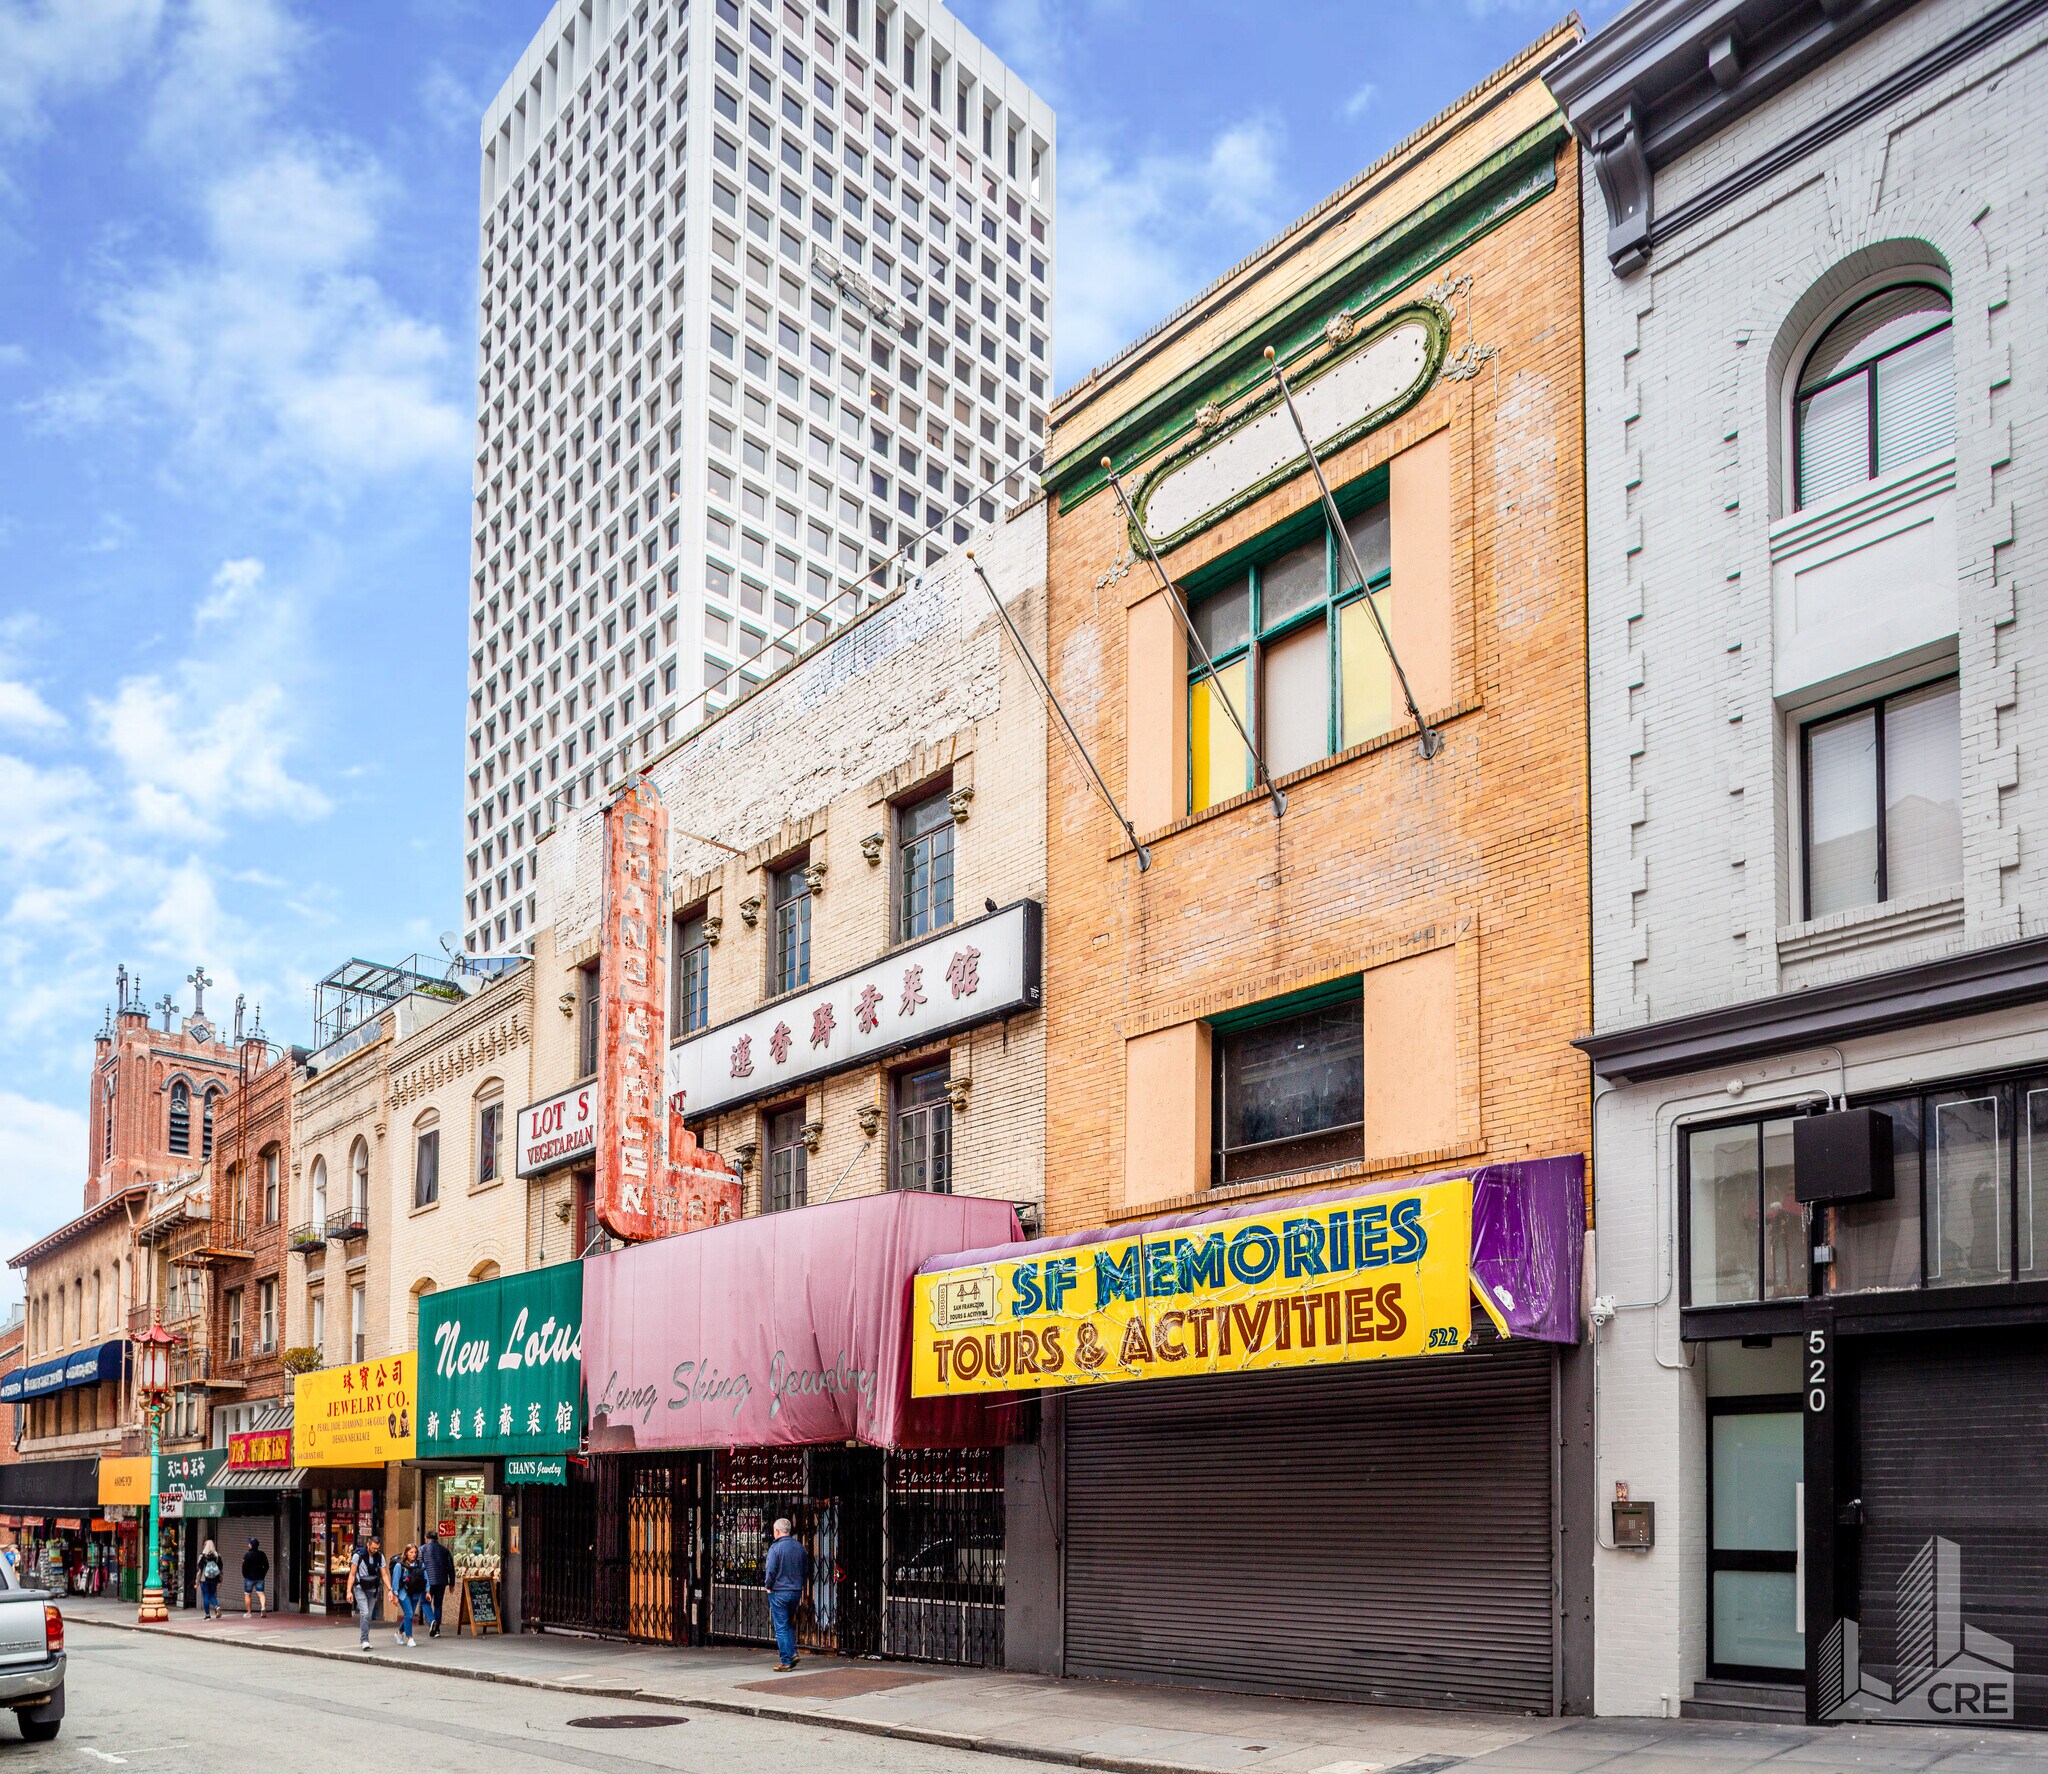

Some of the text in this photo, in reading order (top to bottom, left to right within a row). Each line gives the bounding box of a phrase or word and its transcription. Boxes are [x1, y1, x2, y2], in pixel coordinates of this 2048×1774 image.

[527, 1124, 594, 1166] VEGETARIAN
[1012, 1198, 1429, 1317] SF MEMORIES
[434, 1320, 490, 1379] New
[933, 1282, 1407, 1383] TOURS & ACTIVITIES
[1428, 1326, 1459, 1348] 522
[343, 1360, 402, 1394] 珠寶公司
[595, 1350, 878, 1425] Lung Shing Jewelry
[1809, 1330, 1826, 1412] 520
[327, 1390, 410, 1418] JEWELRY CO.
[508, 1462, 562, 1477] CHAN'S Jewelry
